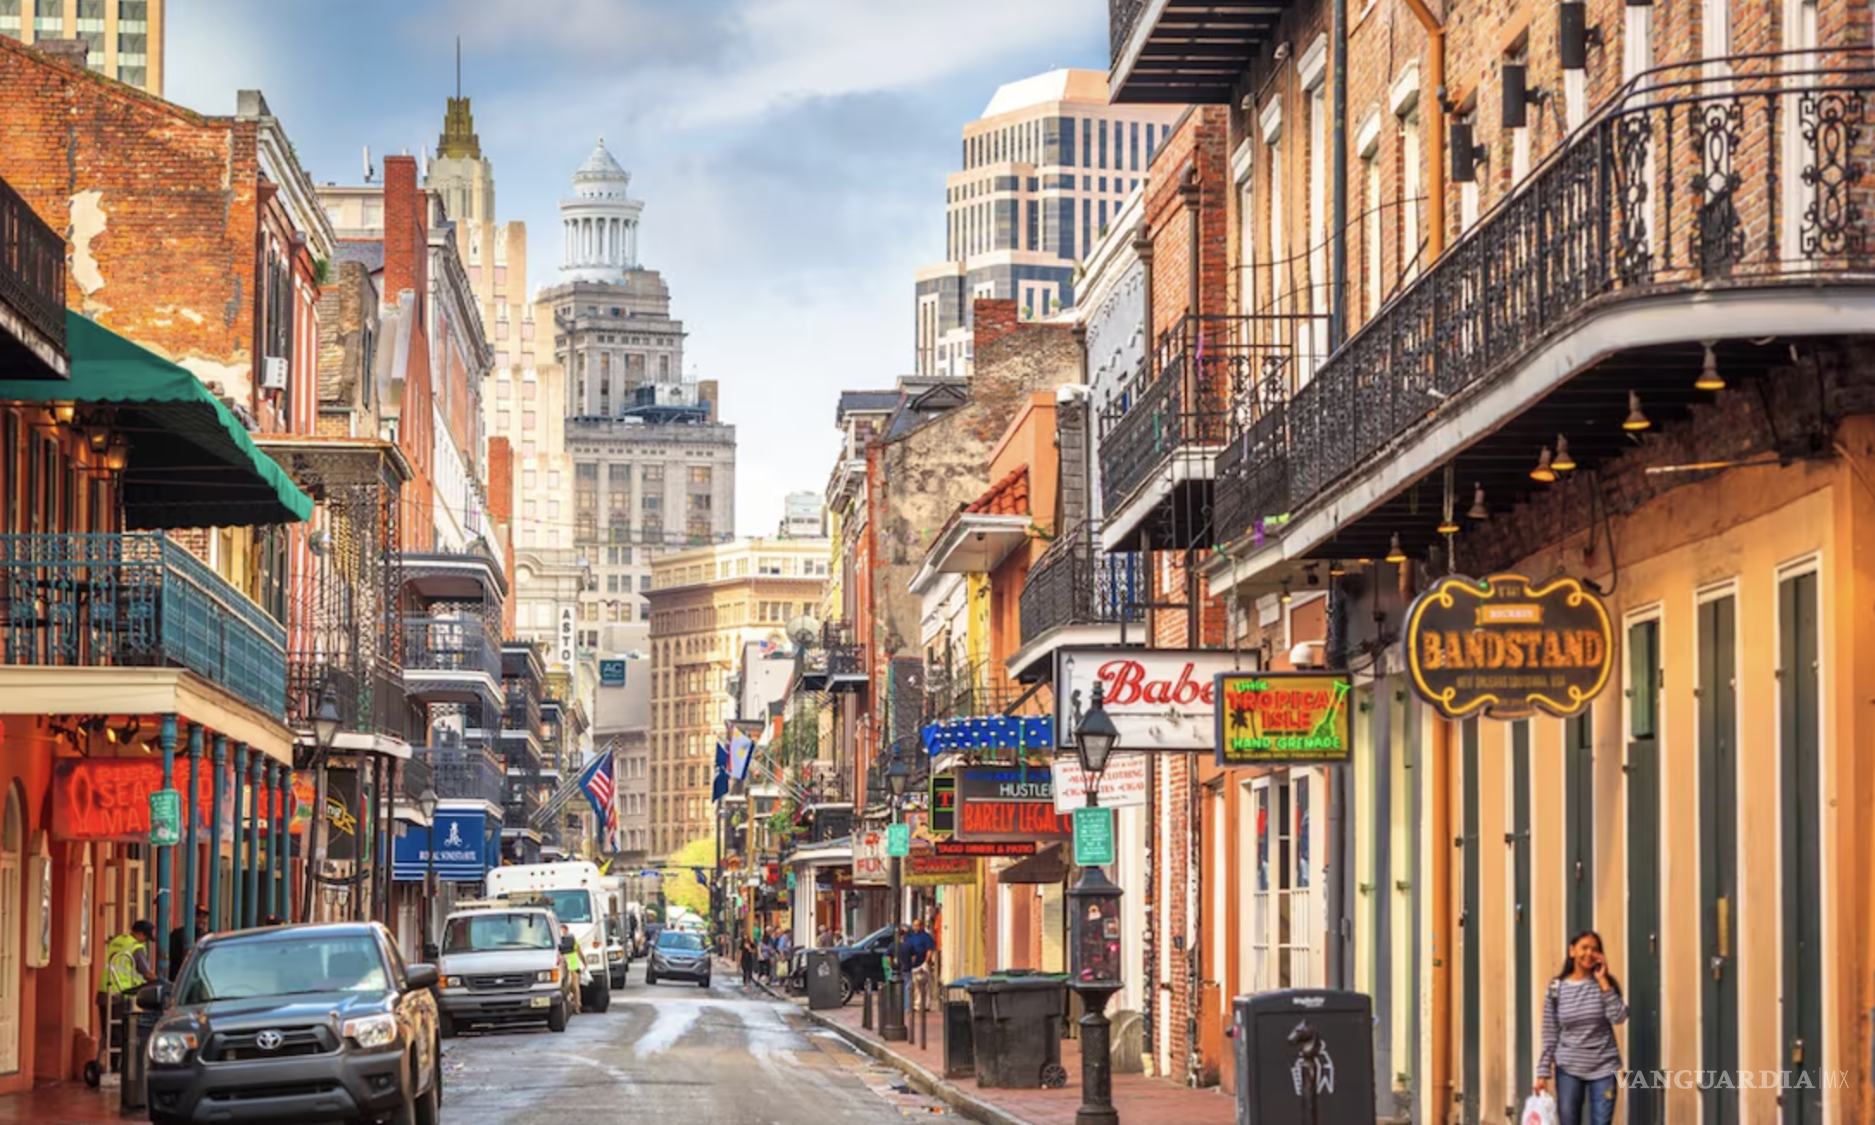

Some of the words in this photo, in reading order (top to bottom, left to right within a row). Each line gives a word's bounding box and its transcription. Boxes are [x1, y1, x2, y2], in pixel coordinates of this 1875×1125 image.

[1423, 630, 1602, 669] BANDSTAND
[604, 662, 623, 674] AC
[1262, 710, 1311, 729] ISLE
[1233, 737, 1272, 750] HAND
[1276, 737, 1341, 750] GRENADE
[97, 765, 157, 783] PIER
[964, 802, 1014, 833] BARELY
[1019, 802, 1060, 833] LEGAL
[936, 844, 964, 854] TACO
[965, 844, 996, 854] DINER
[997, 844, 1004, 854] &
[1006, 844, 1034, 854] PATIO
